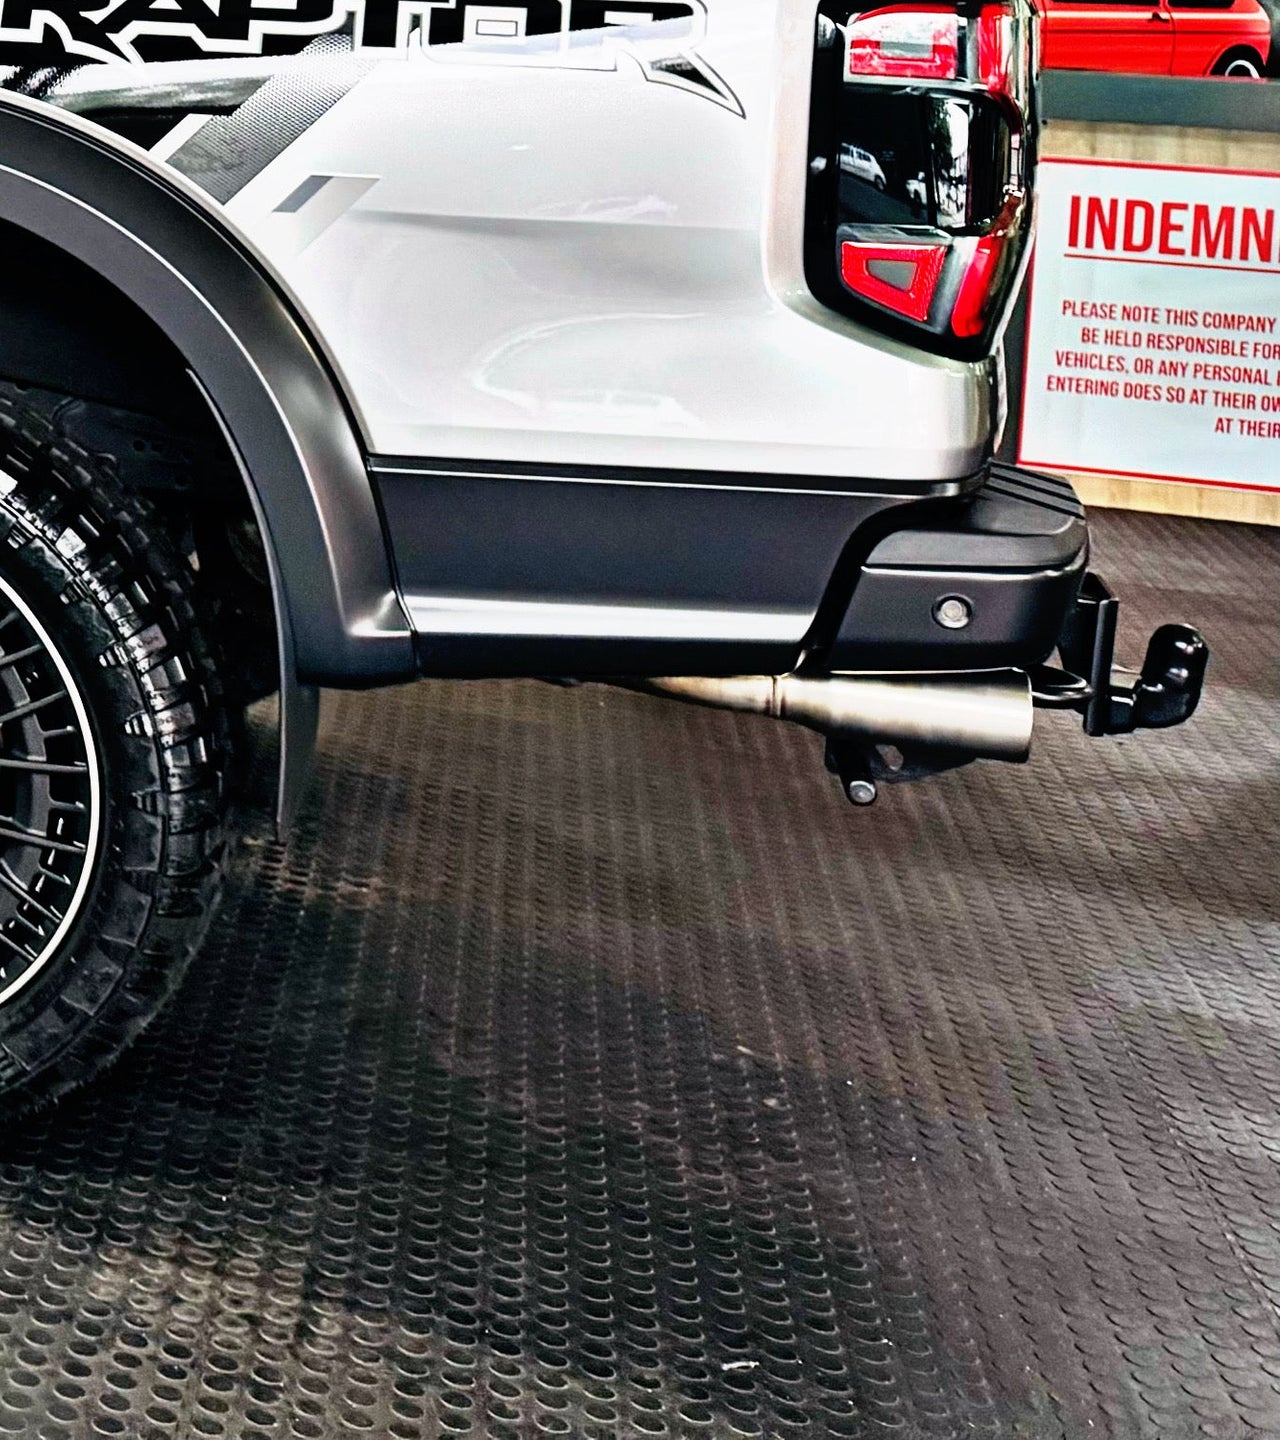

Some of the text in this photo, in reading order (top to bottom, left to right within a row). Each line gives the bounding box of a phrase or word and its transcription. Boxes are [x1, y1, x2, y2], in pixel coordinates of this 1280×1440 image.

[1067, 195, 1280, 264] INDEMN
[1062, 299, 1277, 334] PLEASE NOTE THIS COMPANY
[1081, 326, 1280, 360] BE HELD RESPONSIBLE FOR
[1055, 350, 1129, 375] VEHICLES,
[1134, 357, 1154, 374] OR
[1158, 360, 1188, 378] ANY
[1192, 363, 1272, 386] PERSONAL
[1046, 375, 1119, 397] ENTERING
[1123, 382, 1162, 401] DOES
[1166, 387, 1186, 404] SO
[1190, 389, 1208, 406] AT
[1213, 390, 1257, 411] THEIR
[1214, 417, 1280, 439] AT THEIR
